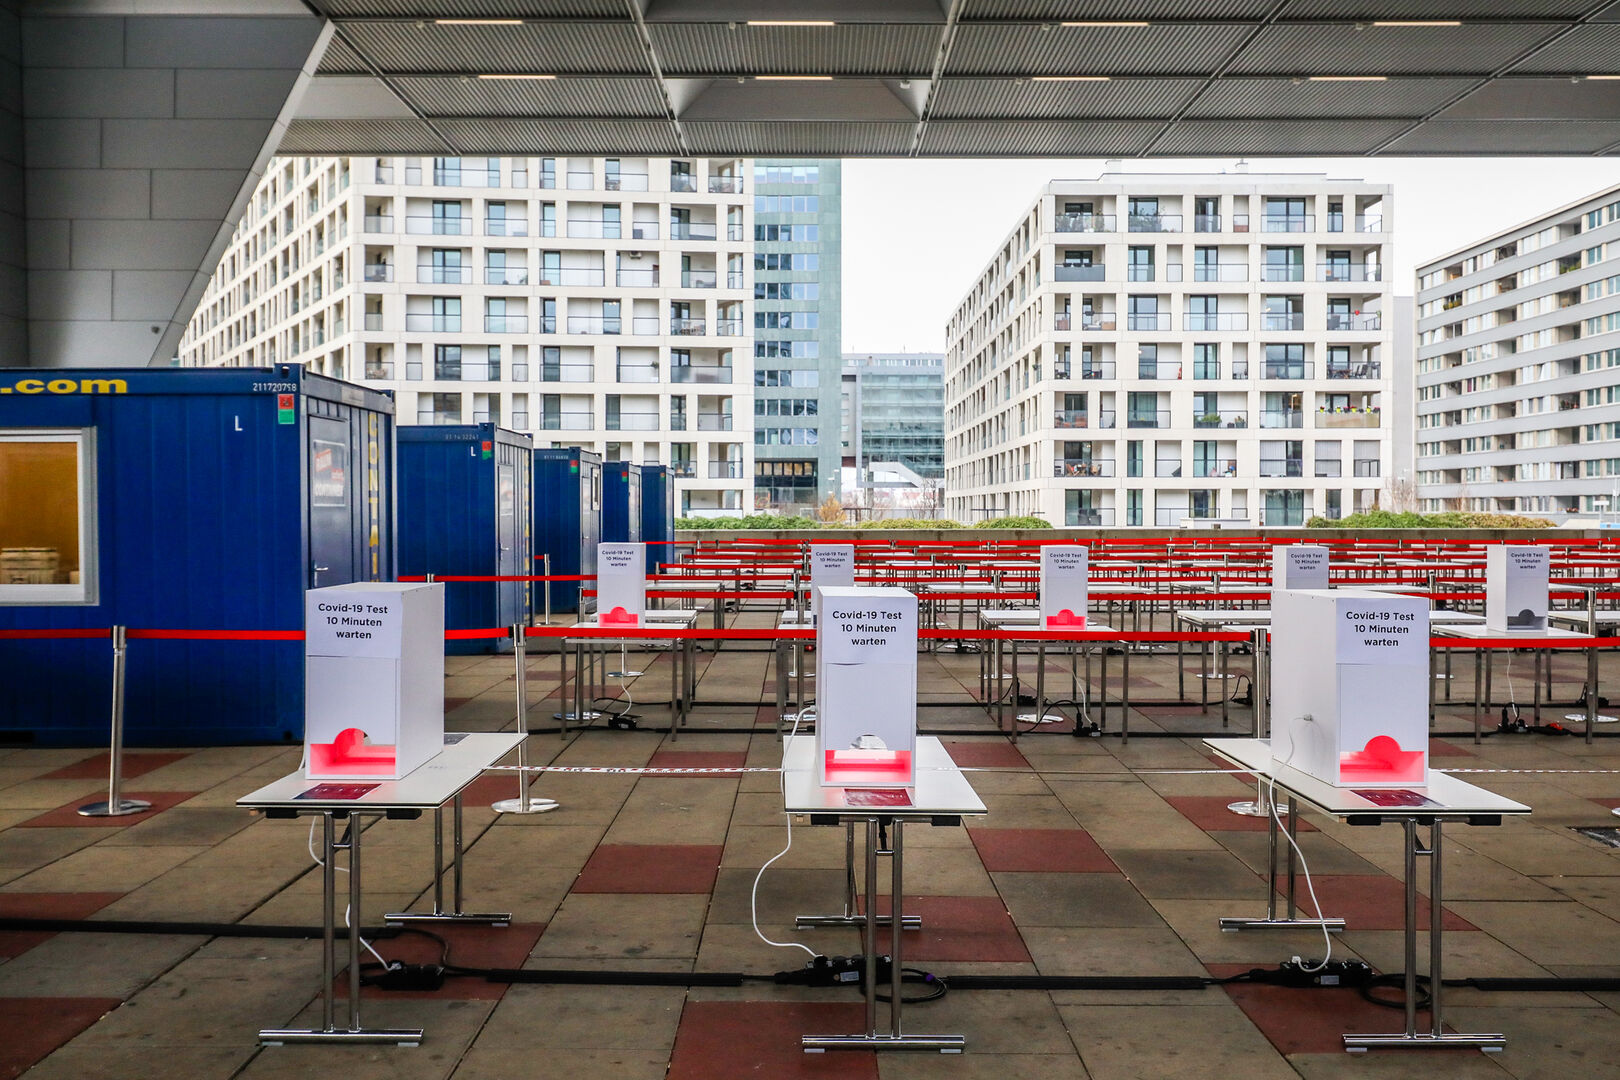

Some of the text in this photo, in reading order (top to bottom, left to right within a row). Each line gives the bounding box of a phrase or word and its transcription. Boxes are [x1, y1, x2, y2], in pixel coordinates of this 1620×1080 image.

[0, 379, 128, 394] .com
[235, 415, 243, 431] L
[470, 446, 476, 456] L
[318, 603, 389, 614] Covid-19 Test
[832, 611, 902, 620] Covid-19 Test
[1346, 611, 1415, 620] Covid-19 Test
[326, 616, 382, 626] 10 Minuten
[841, 624, 897, 632] 10 Minuten
[1354, 625, 1409, 633] 10 Minuten
[336, 630, 372, 639] warten
[1364, 638, 1399, 646] warten
